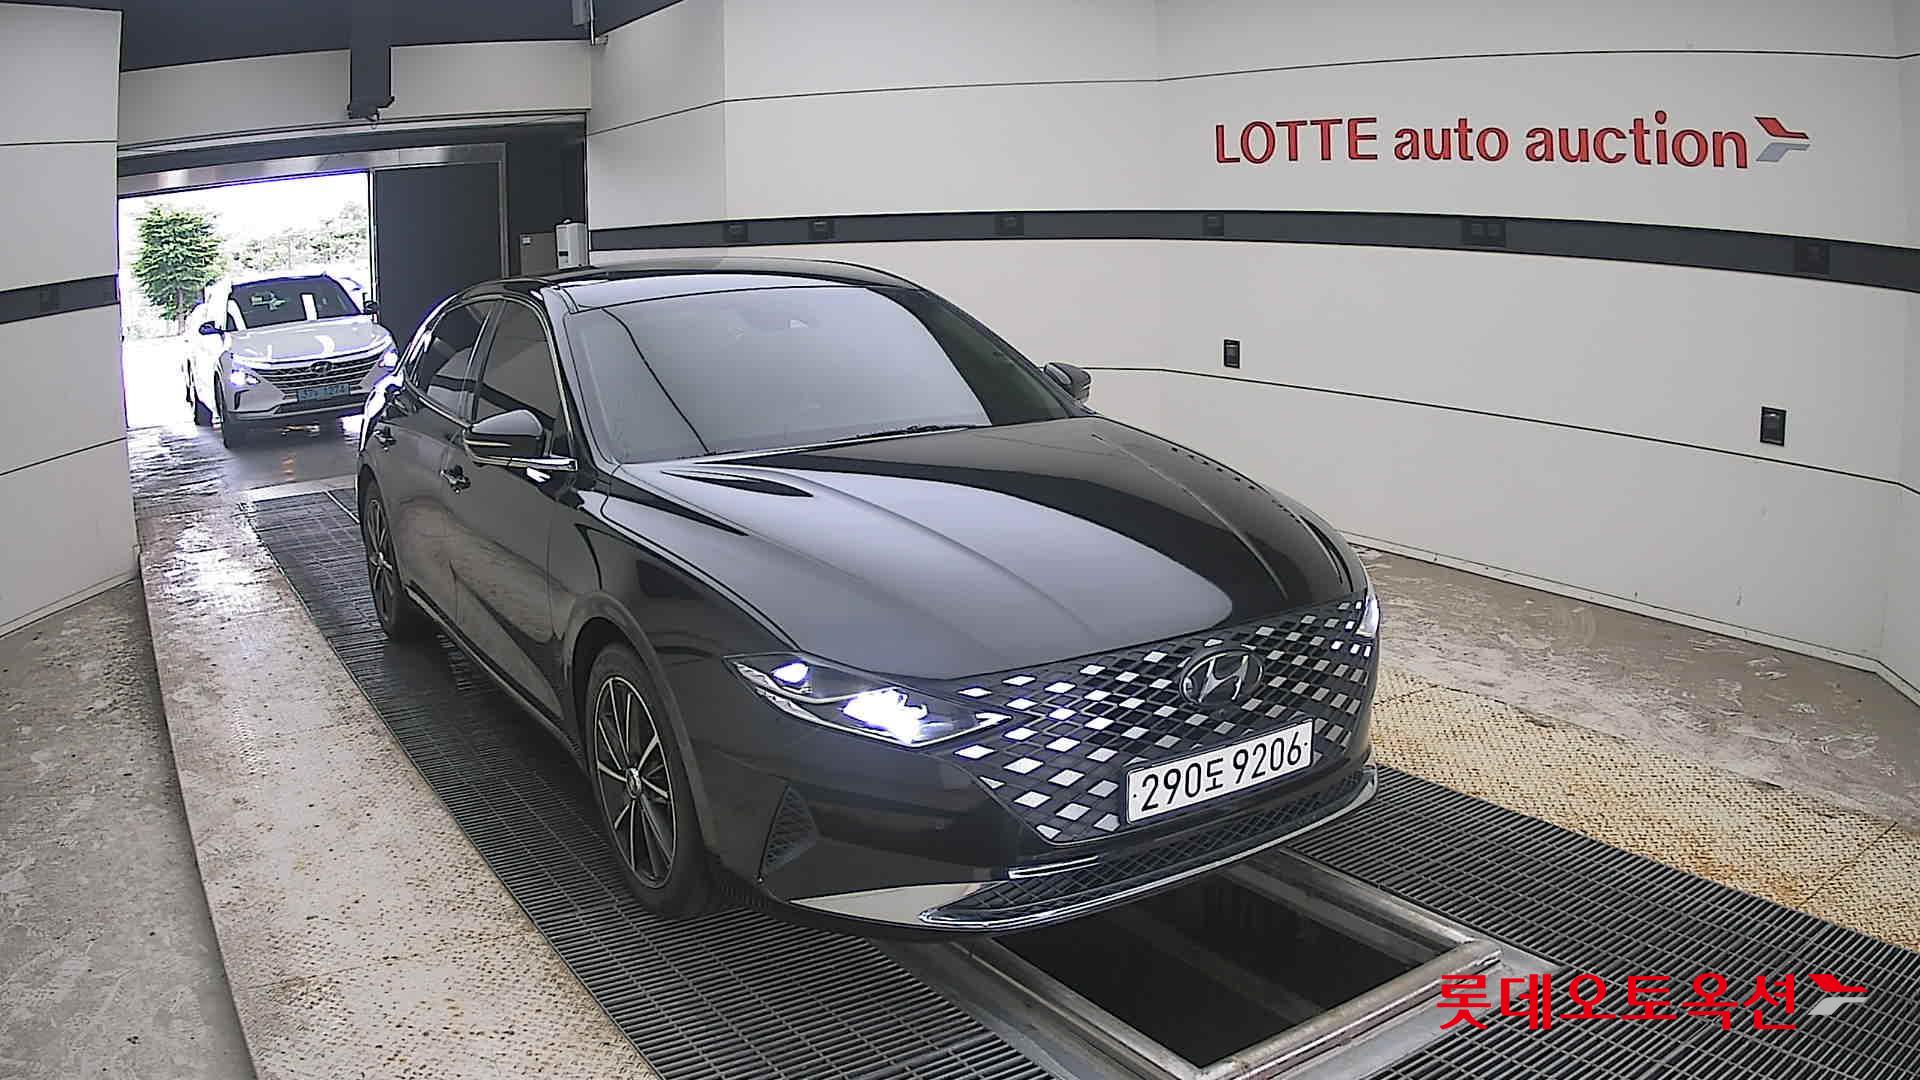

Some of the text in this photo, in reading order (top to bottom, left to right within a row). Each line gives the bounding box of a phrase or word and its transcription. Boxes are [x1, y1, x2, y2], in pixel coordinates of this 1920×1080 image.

[1215, 110, 1748, 169] LOTTE auto auction
[1141, 731, 1301, 812] 290도 9206
